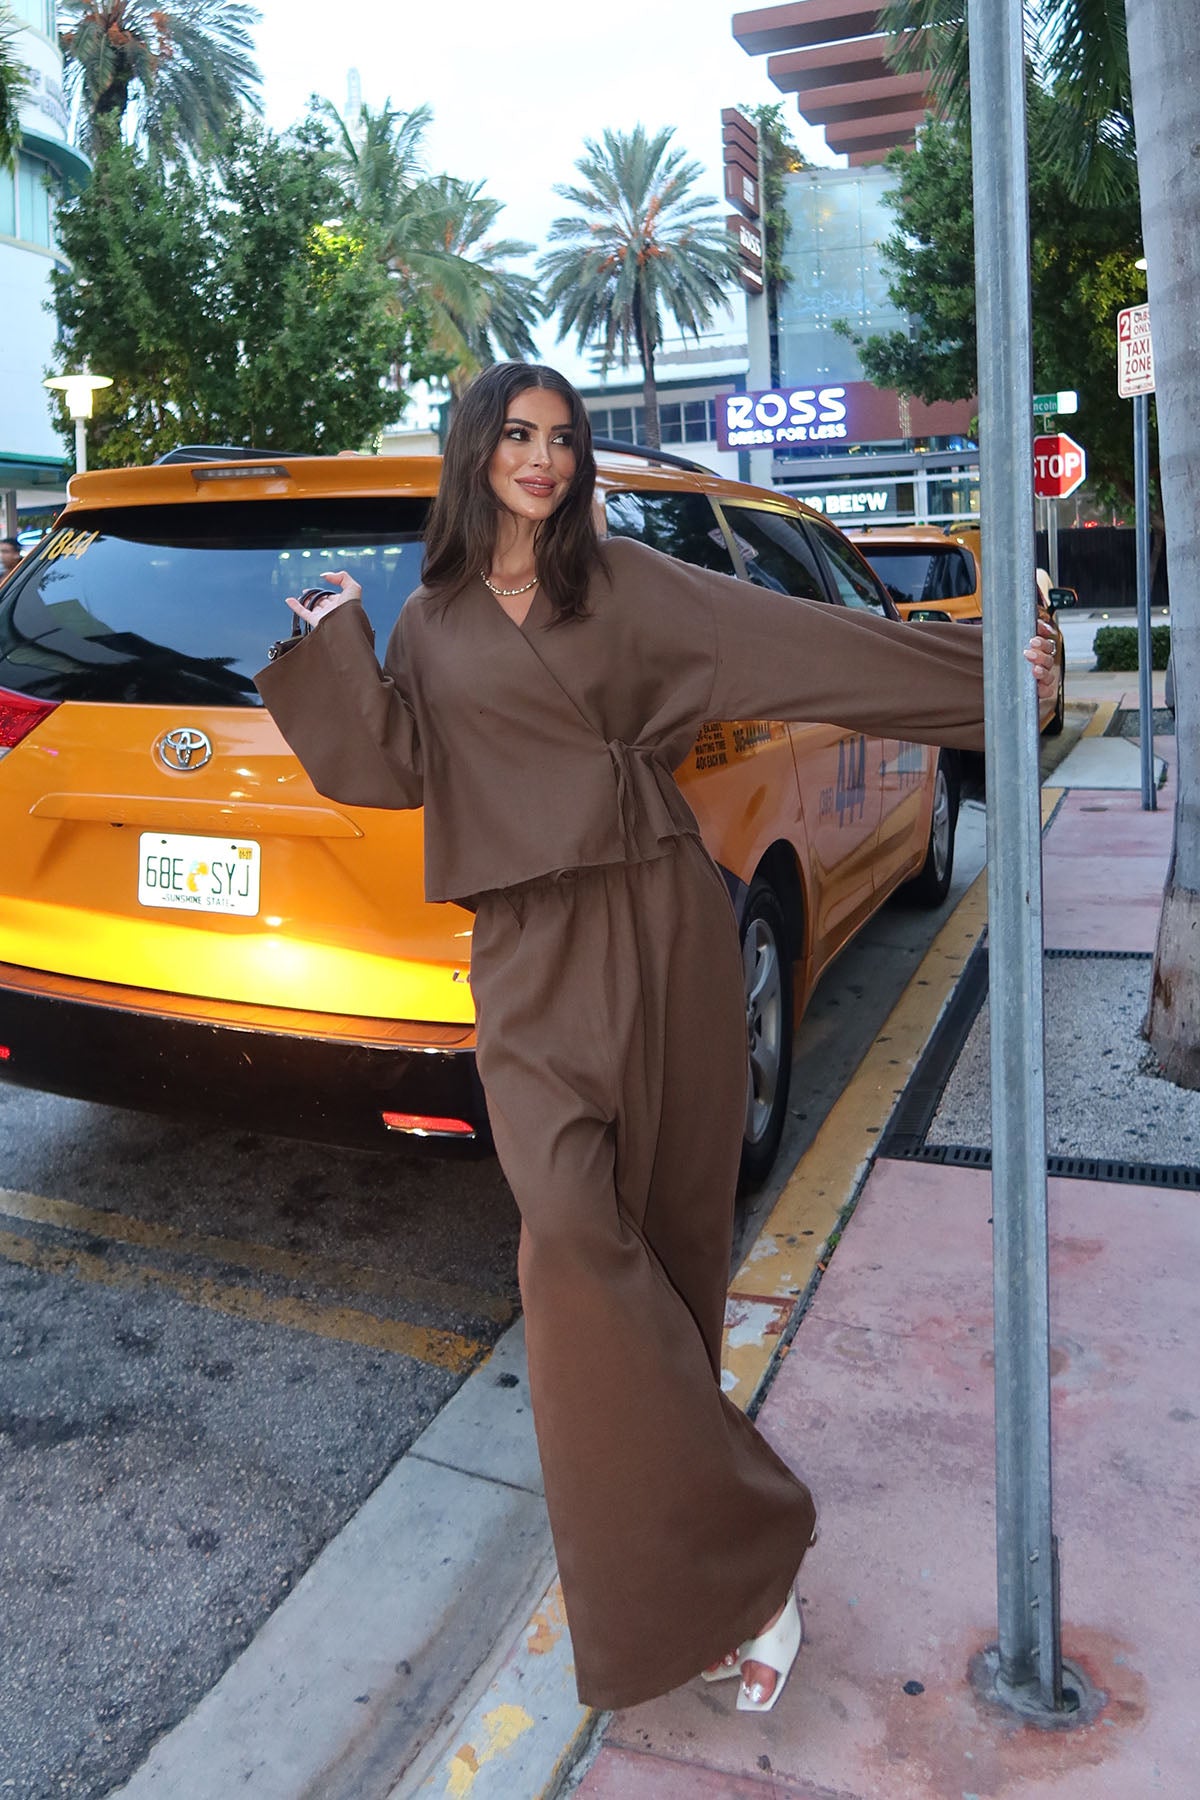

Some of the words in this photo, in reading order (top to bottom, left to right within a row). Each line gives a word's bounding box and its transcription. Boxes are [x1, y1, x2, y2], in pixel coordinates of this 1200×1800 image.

[1120, 313, 1130, 338] 2
[1126, 338, 1150, 358] TAXI
[1125, 356, 1151, 375] ZONE
[727, 387, 847, 430] ROSS
[1033, 401, 1058, 412] ncoln
[728, 429, 775, 447] DRESS
[776, 426, 808, 442] FOR
[809, 423, 848, 440] LESS
[826, 492, 888, 514] BELOW
[40, 528, 100, 561] 1844
[146, 855, 184, 891] 68E
[211, 861, 250, 898] SYJ
[165, 893, 202, 905] SUNSHINE
[206, 896, 229, 907] STATE
